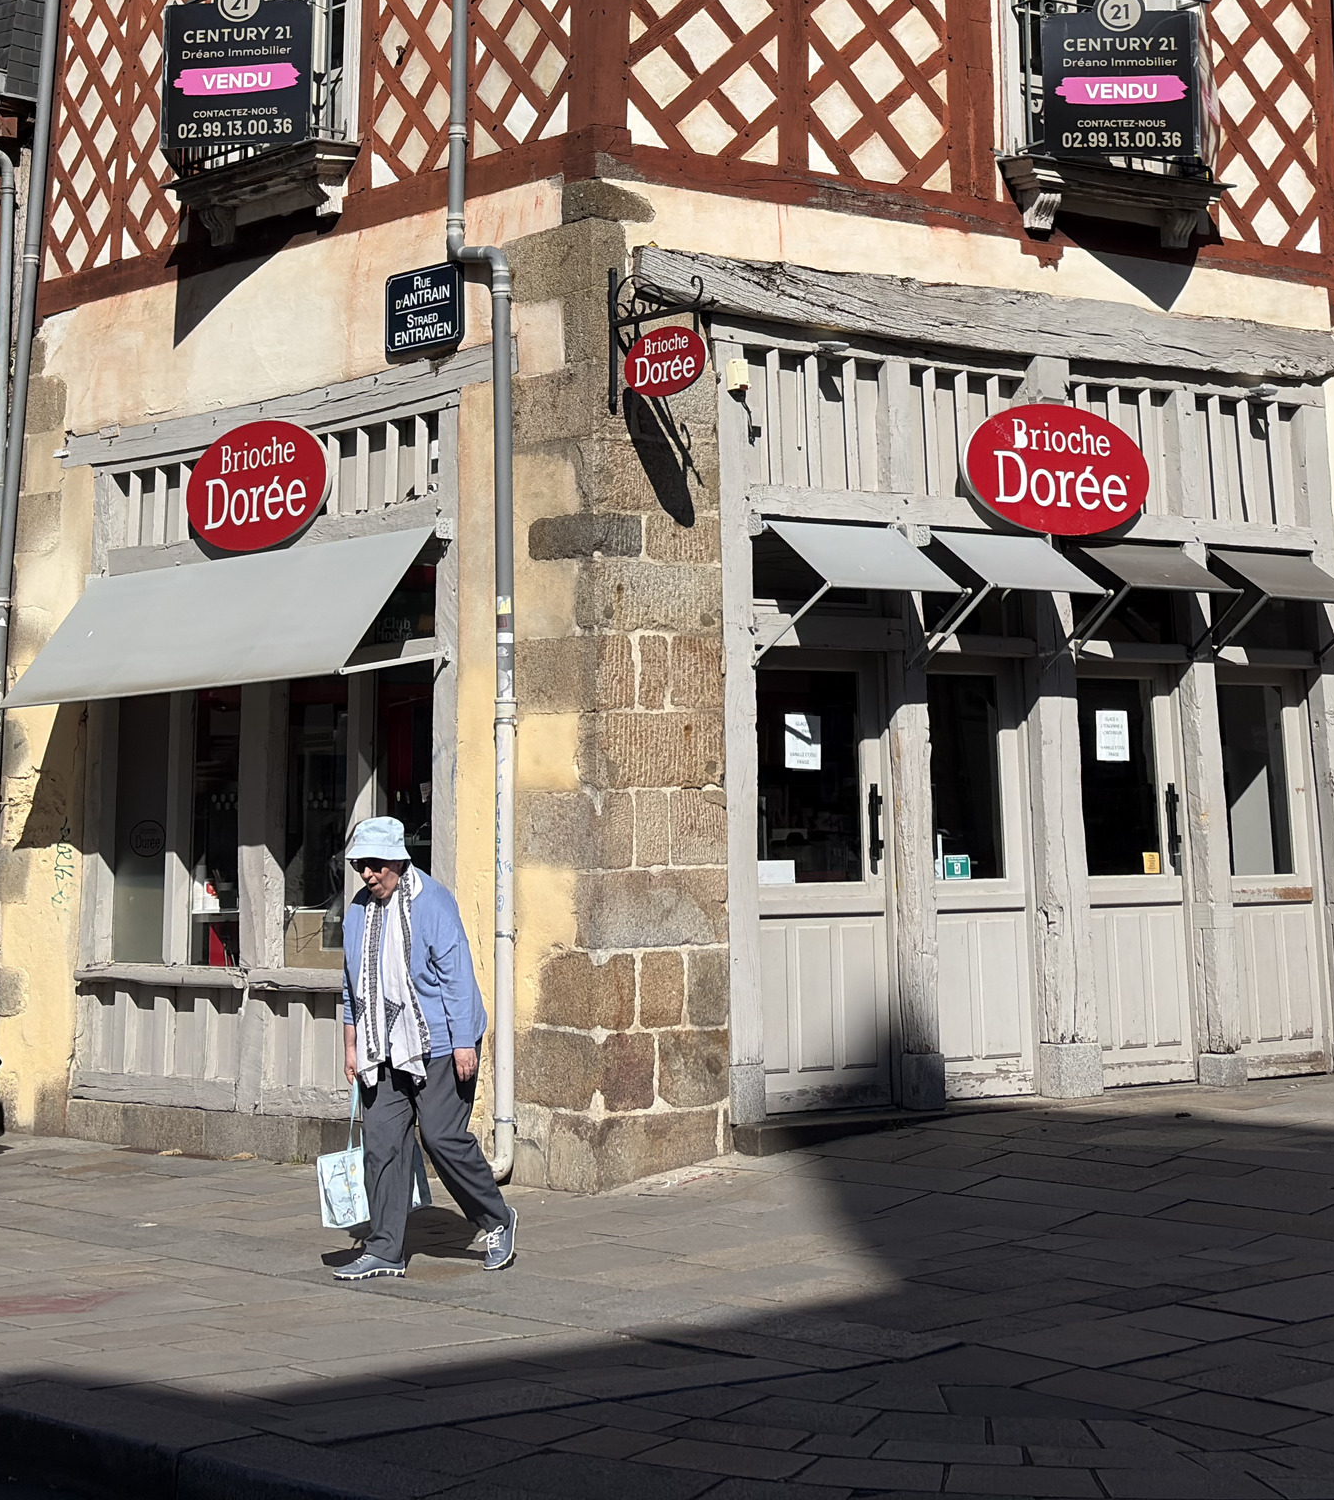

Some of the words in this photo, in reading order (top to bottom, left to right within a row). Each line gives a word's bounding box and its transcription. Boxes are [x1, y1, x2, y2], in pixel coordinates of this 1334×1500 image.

[1110, 3, 1130, 20] 21
[183, 27, 271, 44] CENTURY
[274, 26, 292, 40] 21
[181, 49, 225, 60] Dréano
[228, 45, 292, 57] Immobilier
[1063, 37, 1154, 52] CENTURY
[1158, 37, 1176, 51] 21
[1062, 57, 1108, 68] Dréano
[1111, 57, 1178, 67] Immobilier
[202, 71, 272, 90] VENDU
[1084, 83, 1158, 99] VENDU
[193, 106, 279, 119] CONTACTEZ-NOUS
[177, 118, 293, 139] 02.99.13.00.36
[1077, 119, 1166, 128] CONTACTEZ-NOUS
[1061, 131, 1182, 148] 02.99.13.00.36
[395, 284, 451, 310] D'ANTRAIN
[406, 312, 439, 329] STRAED
[394, 321, 452, 346] ENTRAVEN
[643, 334, 689, 355] Brioche
[633, 353, 696, 387] Dorée
[1011, 418, 1111, 457] Brioche
[220, 436, 296, 475] Brioche
[993, 450, 1128, 513] Dorée
[204, 475, 307, 531] Dorée
